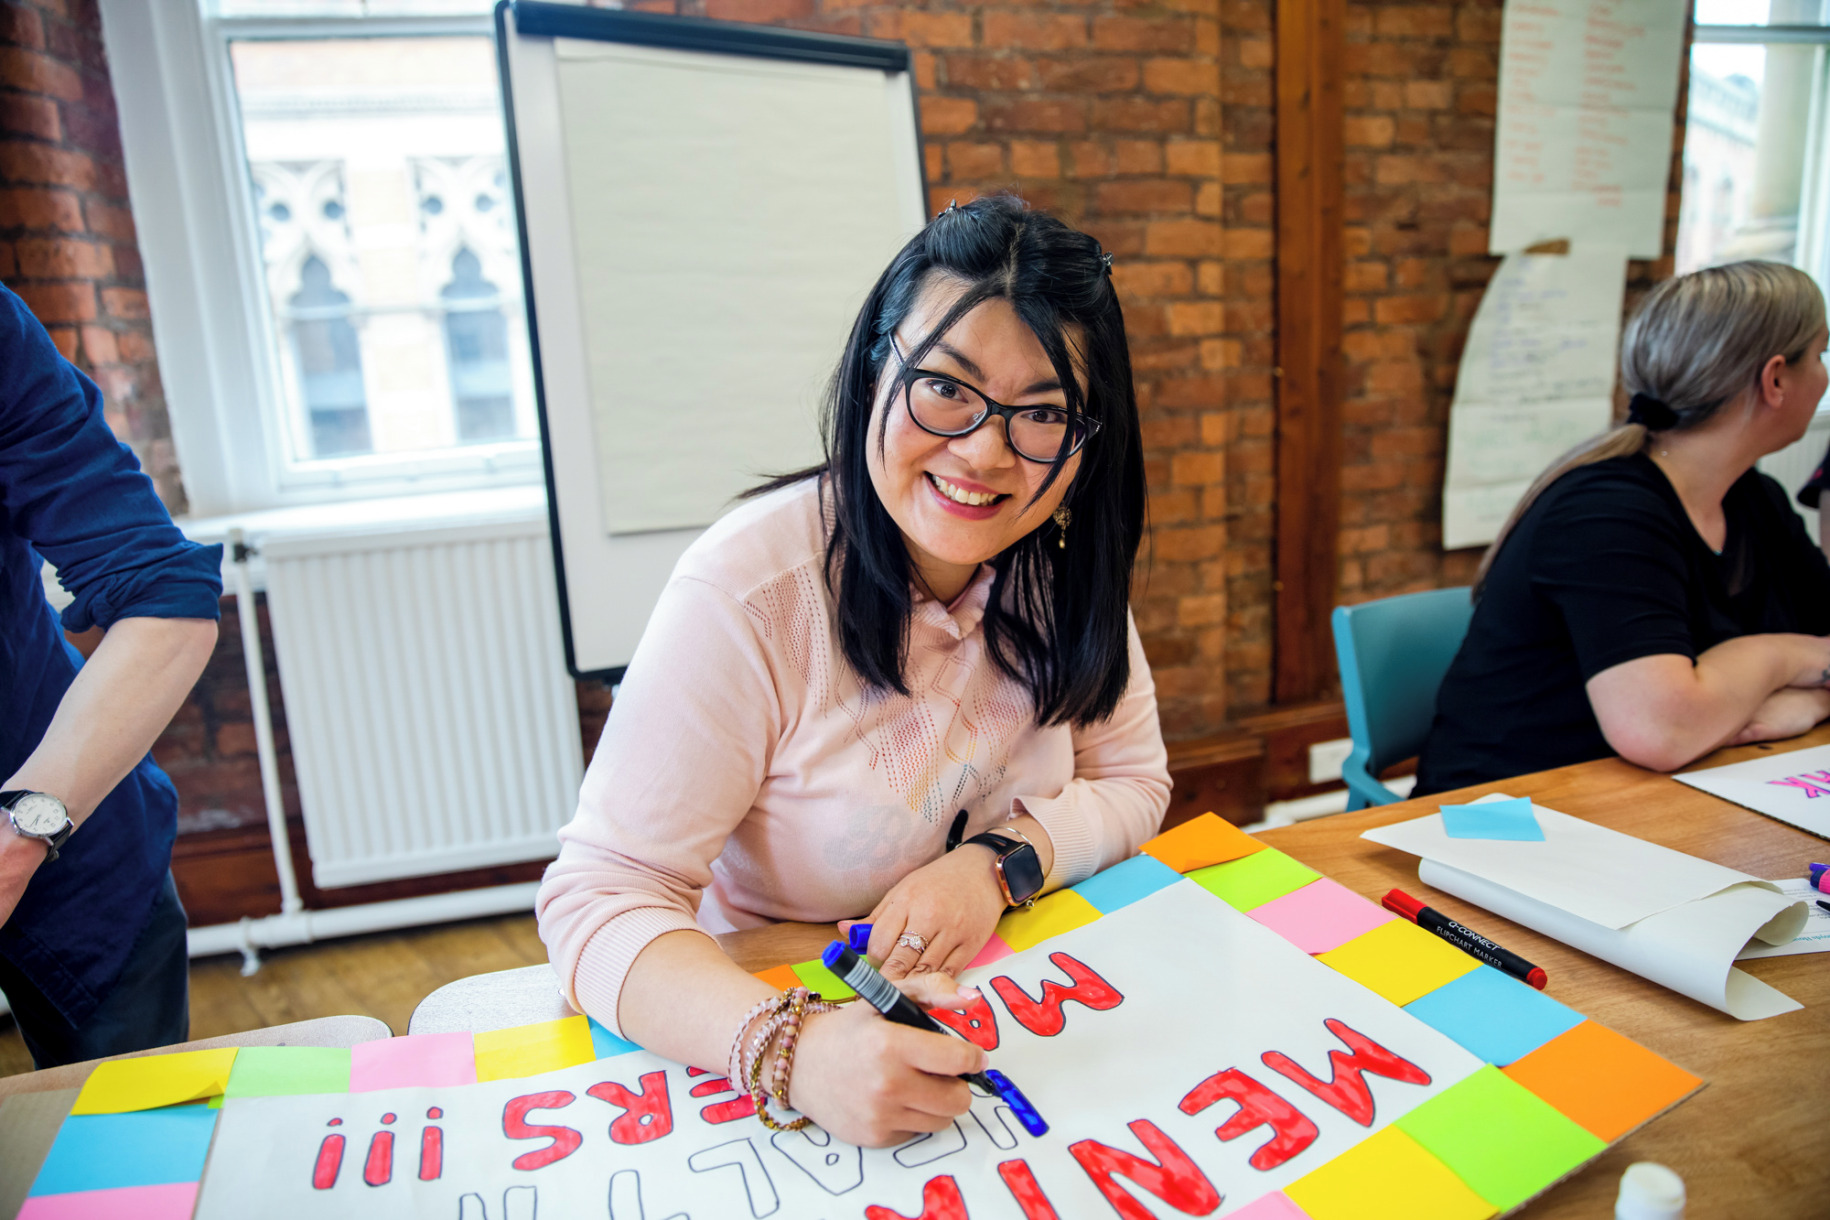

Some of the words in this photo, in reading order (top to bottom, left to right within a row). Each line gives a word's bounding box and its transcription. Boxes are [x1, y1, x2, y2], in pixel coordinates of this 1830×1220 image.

[1436, 925, 1473, 951] FLIPCHART
[1473, 946, 1503, 968] MARKER
[1448, 920, 1501, 951] Q-CONNECT
